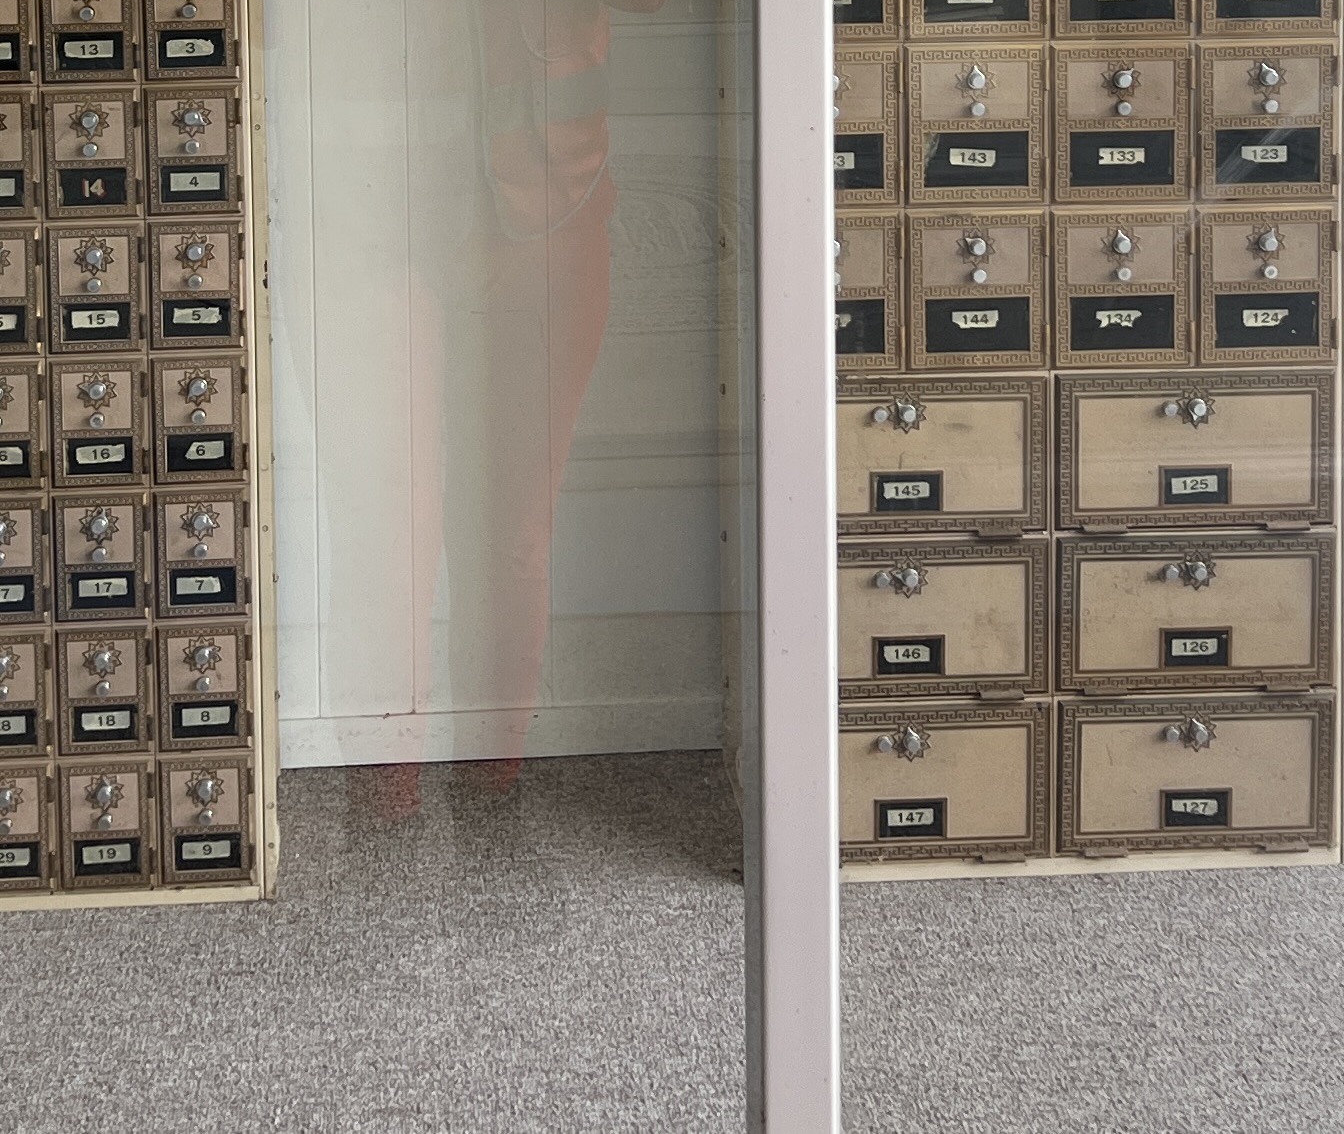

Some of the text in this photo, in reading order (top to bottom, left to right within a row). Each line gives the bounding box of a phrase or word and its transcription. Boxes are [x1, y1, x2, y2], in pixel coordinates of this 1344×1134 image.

[80, 44, 99, 56] 13
[185, 42, 196, 54] 3
[960, 152, 987, 164] 143
[1108, 151, 1136, 162] 133
[1251, 149, 1279, 160] 123
[82, 178, 107, 198] 14
[189, 176, 199, 188] 4
[87, 313, 106, 325] 15
[191, 310, 201, 322] 5
[962, 313, 990, 325] 144
[1106, 314, 1132, 325] 134
[1252, 312, 1280, 324] 124
[92, 448, 111, 460] 16
[195, 445, 206, 456] 6
[893, 485, 921, 496] 145
[1182, 479, 1209, 490] 125
[94, 582, 113, 594] 17
[195, 580, 205, 591] 7
[1182, 641, 1209, 653] 126
[894, 649, 921, 660] 146
[97, 715, 116, 727] 18
[200, 711, 210, 723] 8
[1182, 802, 1209, 814] 127
[897, 812, 925, 823] 147
[98, 849, 117, 860] 19
[203, 844, 213, 855] 9
